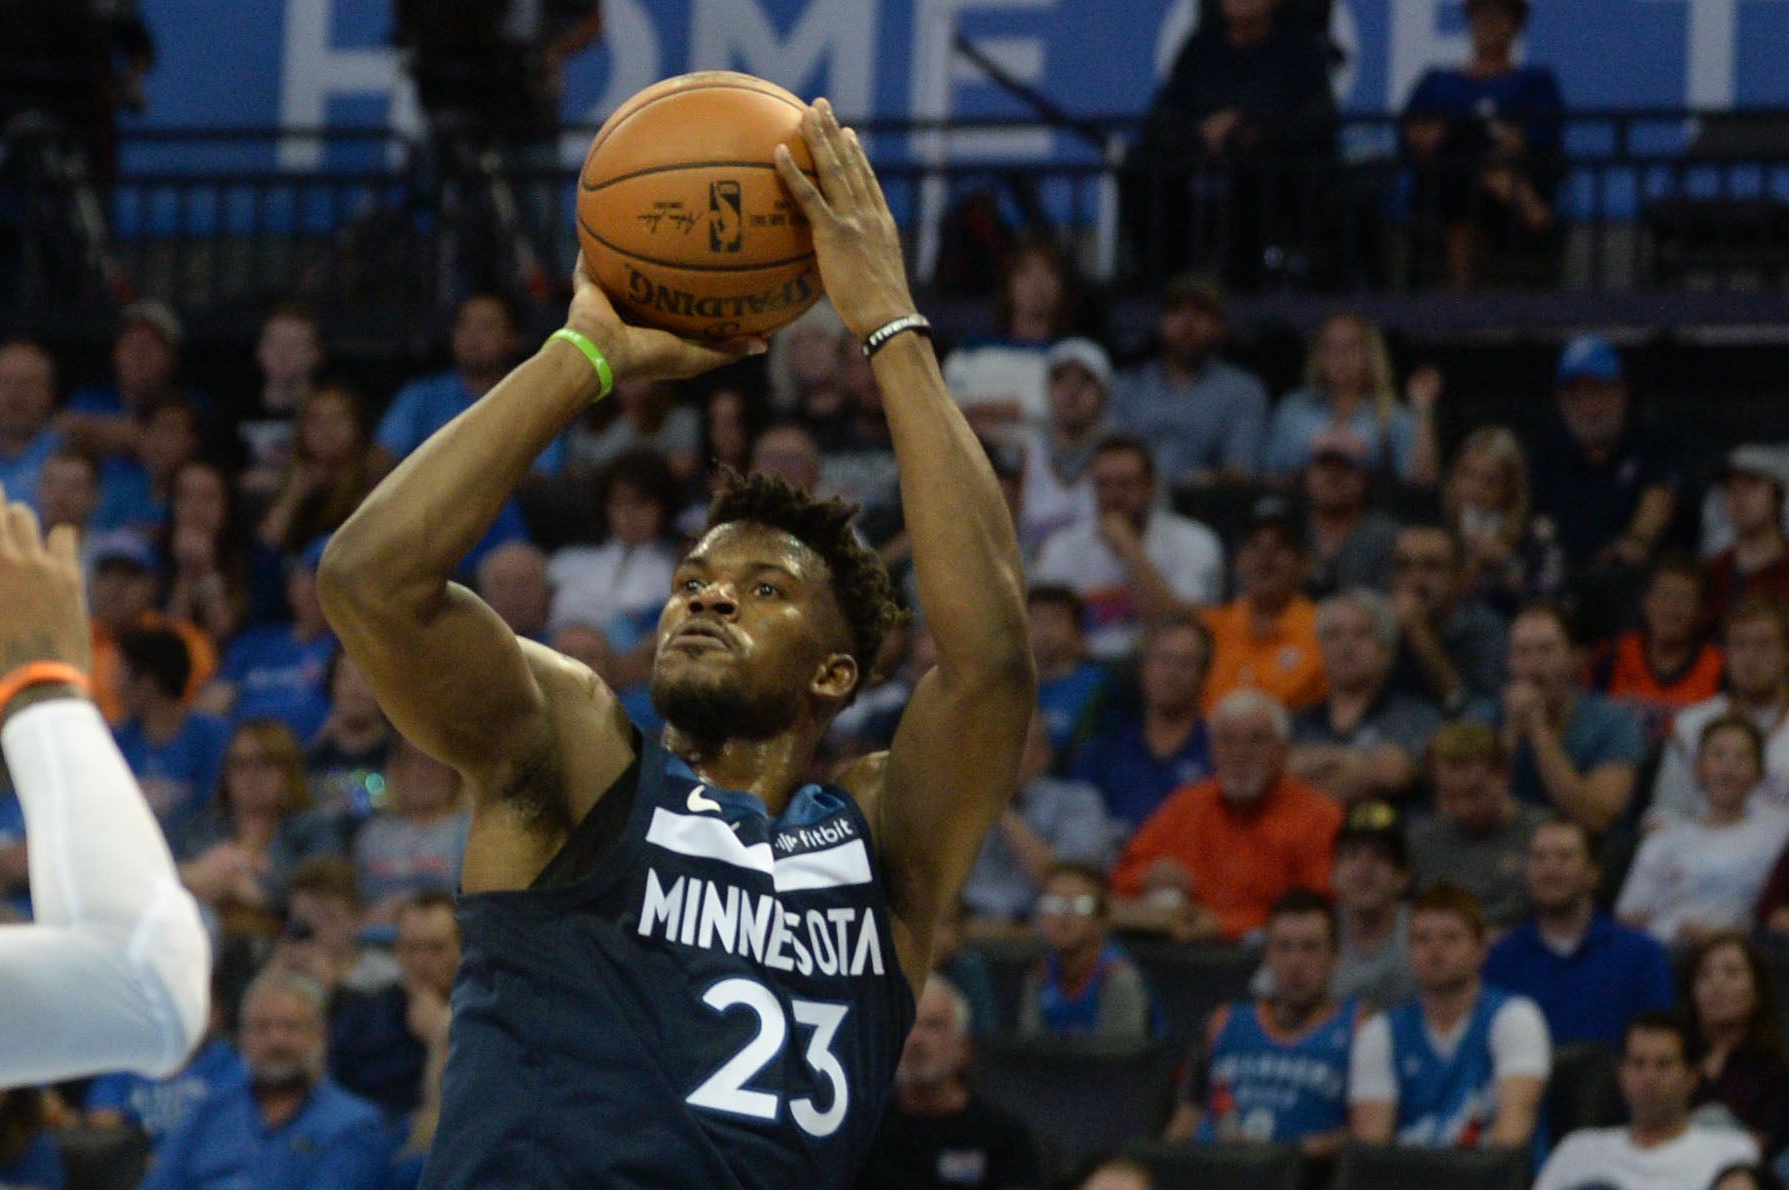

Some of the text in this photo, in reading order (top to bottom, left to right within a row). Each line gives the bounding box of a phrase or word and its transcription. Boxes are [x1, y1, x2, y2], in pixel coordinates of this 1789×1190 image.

[624, 263, 813, 317] SPALDING
[799, 818, 853, 849] fitbit
[637, 866, 885, 977] MINNESOTA
[684, 977, 850, 1138] 23
